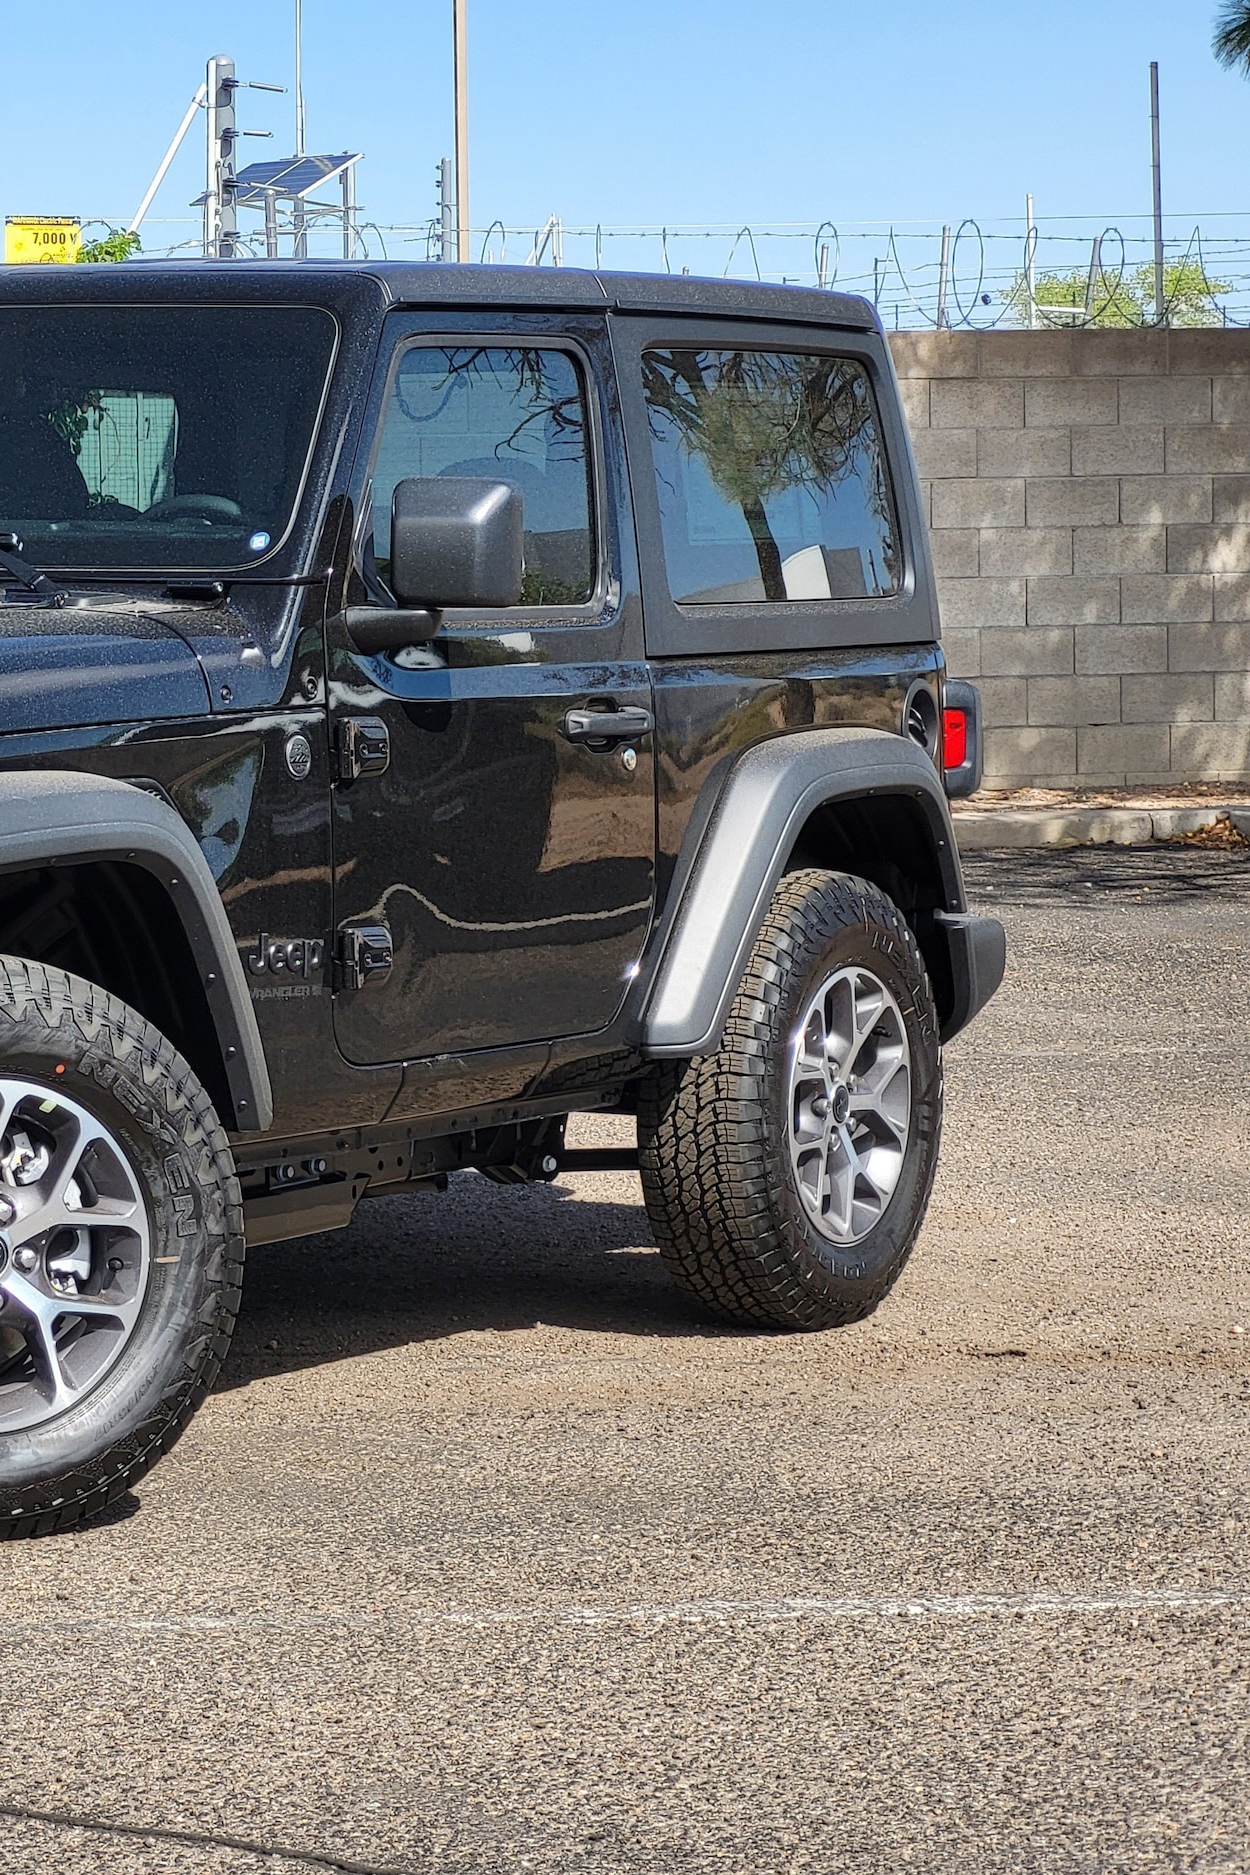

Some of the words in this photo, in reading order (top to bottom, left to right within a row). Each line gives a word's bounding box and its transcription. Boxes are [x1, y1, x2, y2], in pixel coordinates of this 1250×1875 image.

[32, 232, 66, 246] 7,000
[249, 932, 324, 978] Jeep
[76, 1051, 198, 1237] NEXEN
